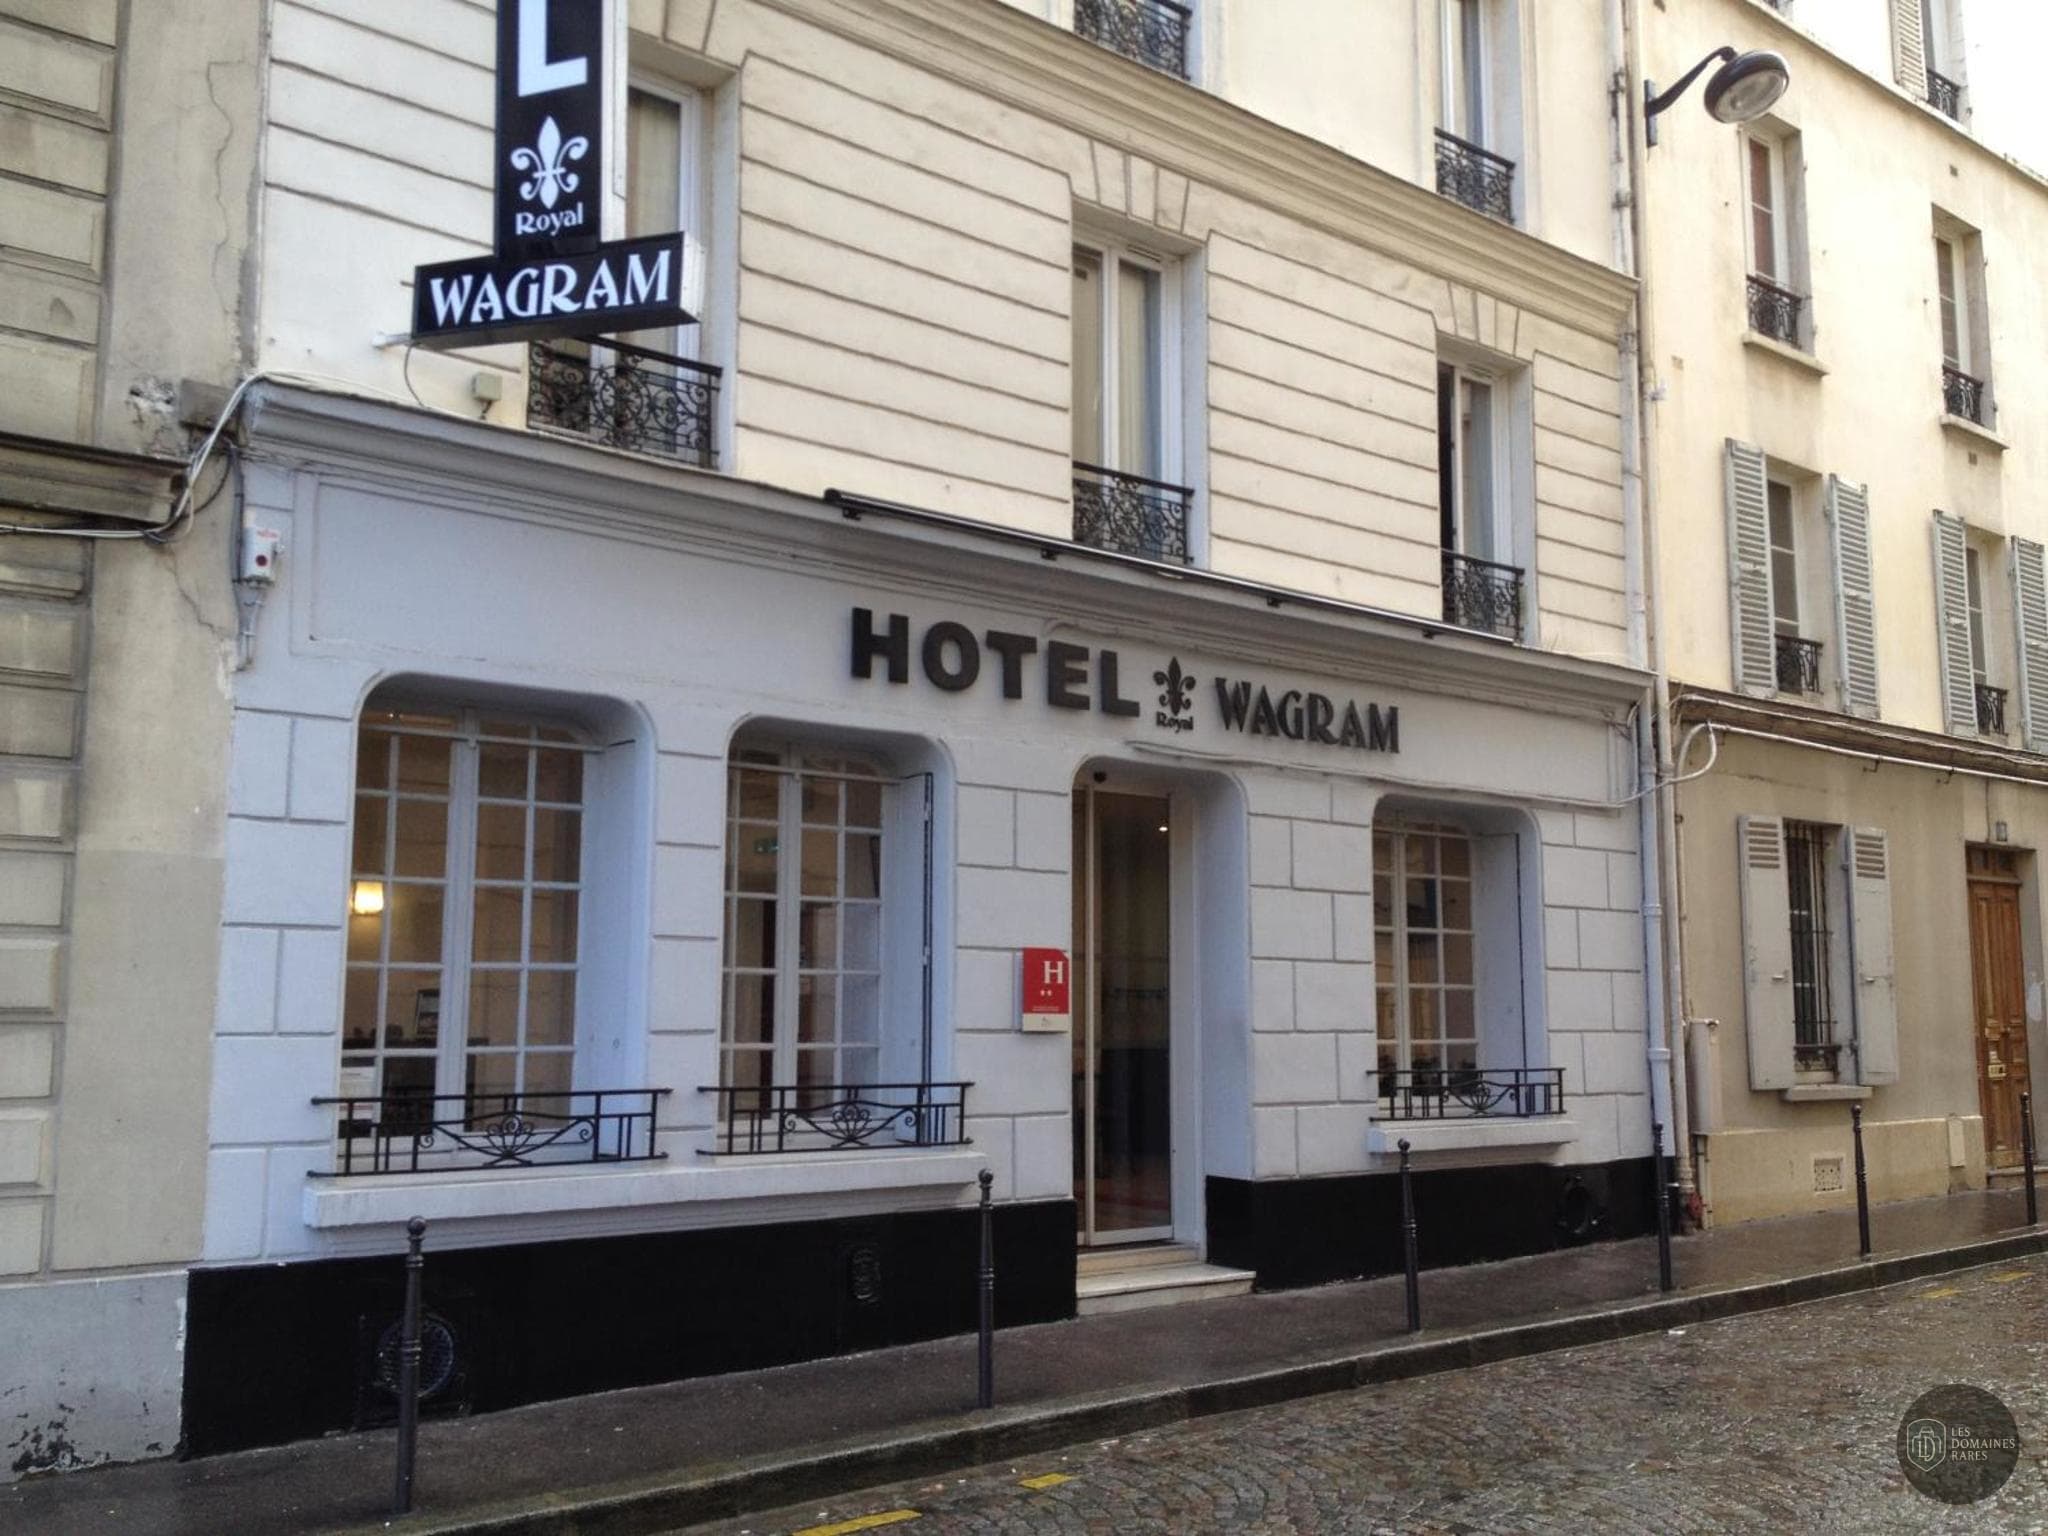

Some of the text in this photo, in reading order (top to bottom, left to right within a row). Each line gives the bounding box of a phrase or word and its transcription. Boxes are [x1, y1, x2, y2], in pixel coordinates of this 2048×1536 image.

[518, 0, 588, 97] L
[515, 202, 584, 236] Royal
[429, 250, 671, 328] WAGRAM
[851, 607, 1400, 754] HOTEL WAGRAM
[1156, 711, 1194, 734] Royal
[1043, 960, 1064, 984] H
